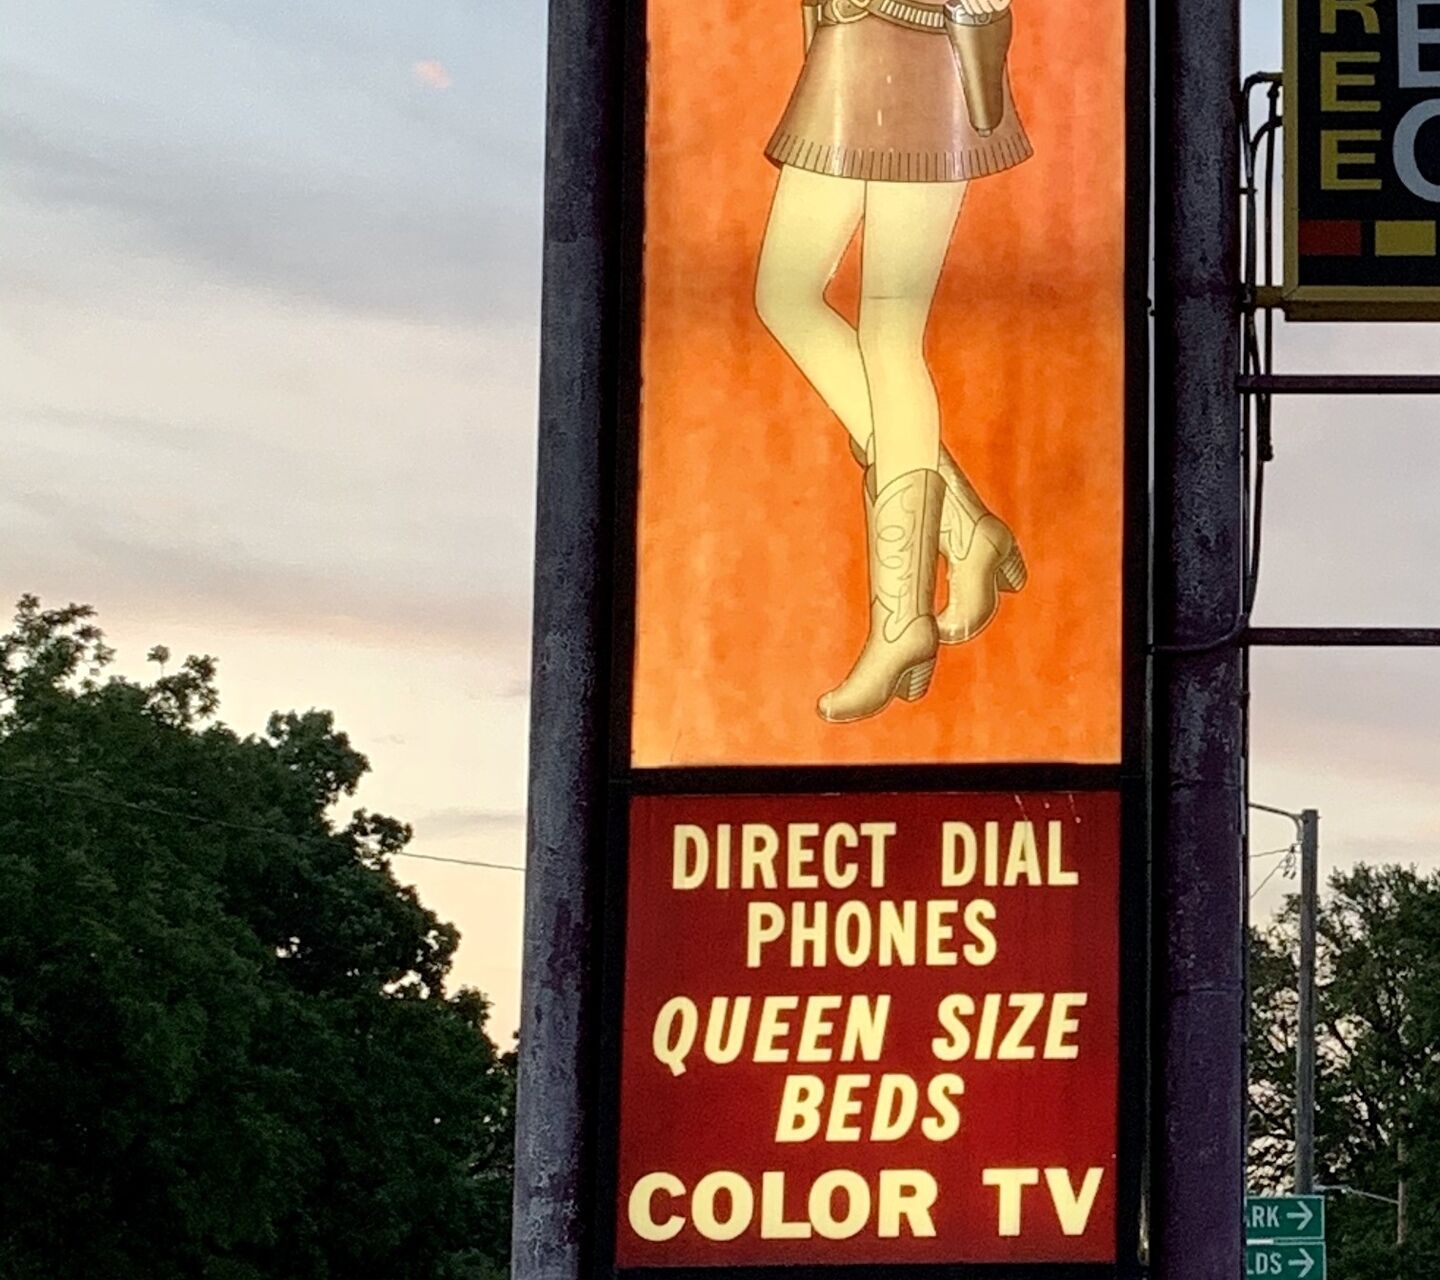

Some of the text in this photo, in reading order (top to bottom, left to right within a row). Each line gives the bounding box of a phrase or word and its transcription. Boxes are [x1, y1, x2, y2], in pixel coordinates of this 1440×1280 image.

[672, 820, 1079, 890] DIRECT DIAL
[747, 899, 998, 968] PHONES
[652, 992, 1088, 1076] QUEEN SIZE
[775, 1073, 965, 1143] BEDS
[628, 1167, 1104, 1242] COLOR TV
